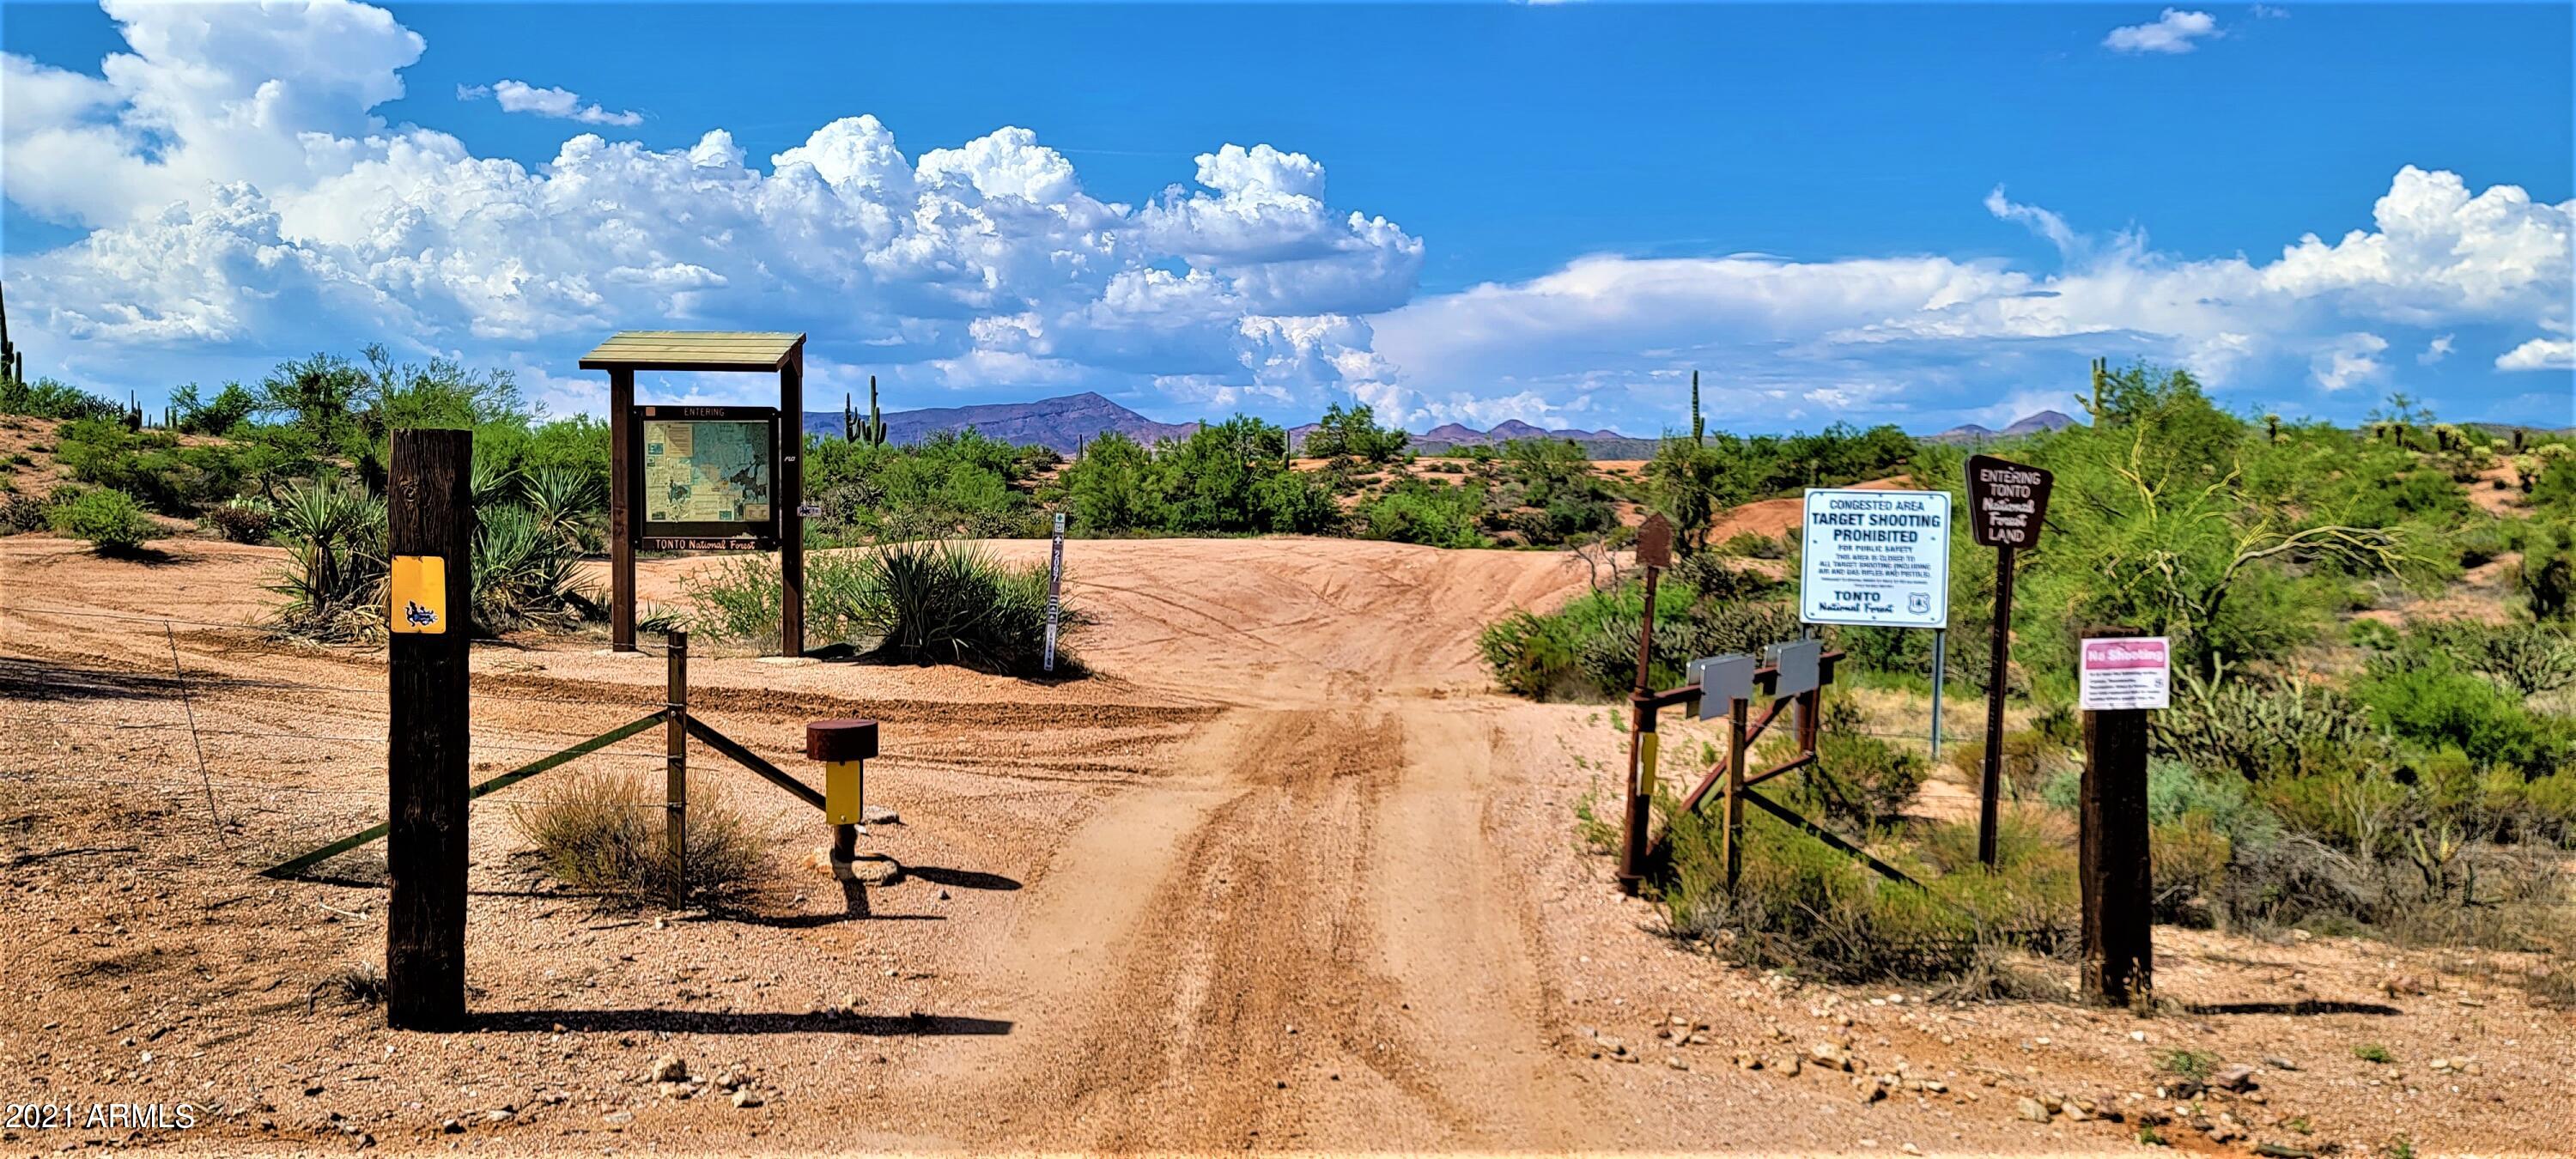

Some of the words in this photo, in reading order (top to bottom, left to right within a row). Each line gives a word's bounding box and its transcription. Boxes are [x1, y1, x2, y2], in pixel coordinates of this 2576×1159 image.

[684, 408, 725, 416] ENTERING
[1980, 469, 2041, 485] ENTERING
[1990, 483, 2031, 498] TONTO
[1830, 500, 1893, 511] CONGESTED
[1895, 501, 1924, 512] AREA
[1982, 497, 2035, 513] National
[1812, 513, 1865, 525] TARGET
[1868, 513, 1941, 527] SHOOTING
[1988, 512, 2028, 527] Forest
[1833, 529, 1918, 543] PROHIBITED
[1988, 528, 2025, 543] LAND
[656, 540, 685, 549] TONTO
[689, 539, 726, 549] National
[729, 540, 755, 549] Forest
[1834, 591, 1880, 601] TONTO
[1819, 602, 1860, 612] National
[1864, 603, 1894, 613] Forest
[2107, 648, 2164, 662] Shooting
